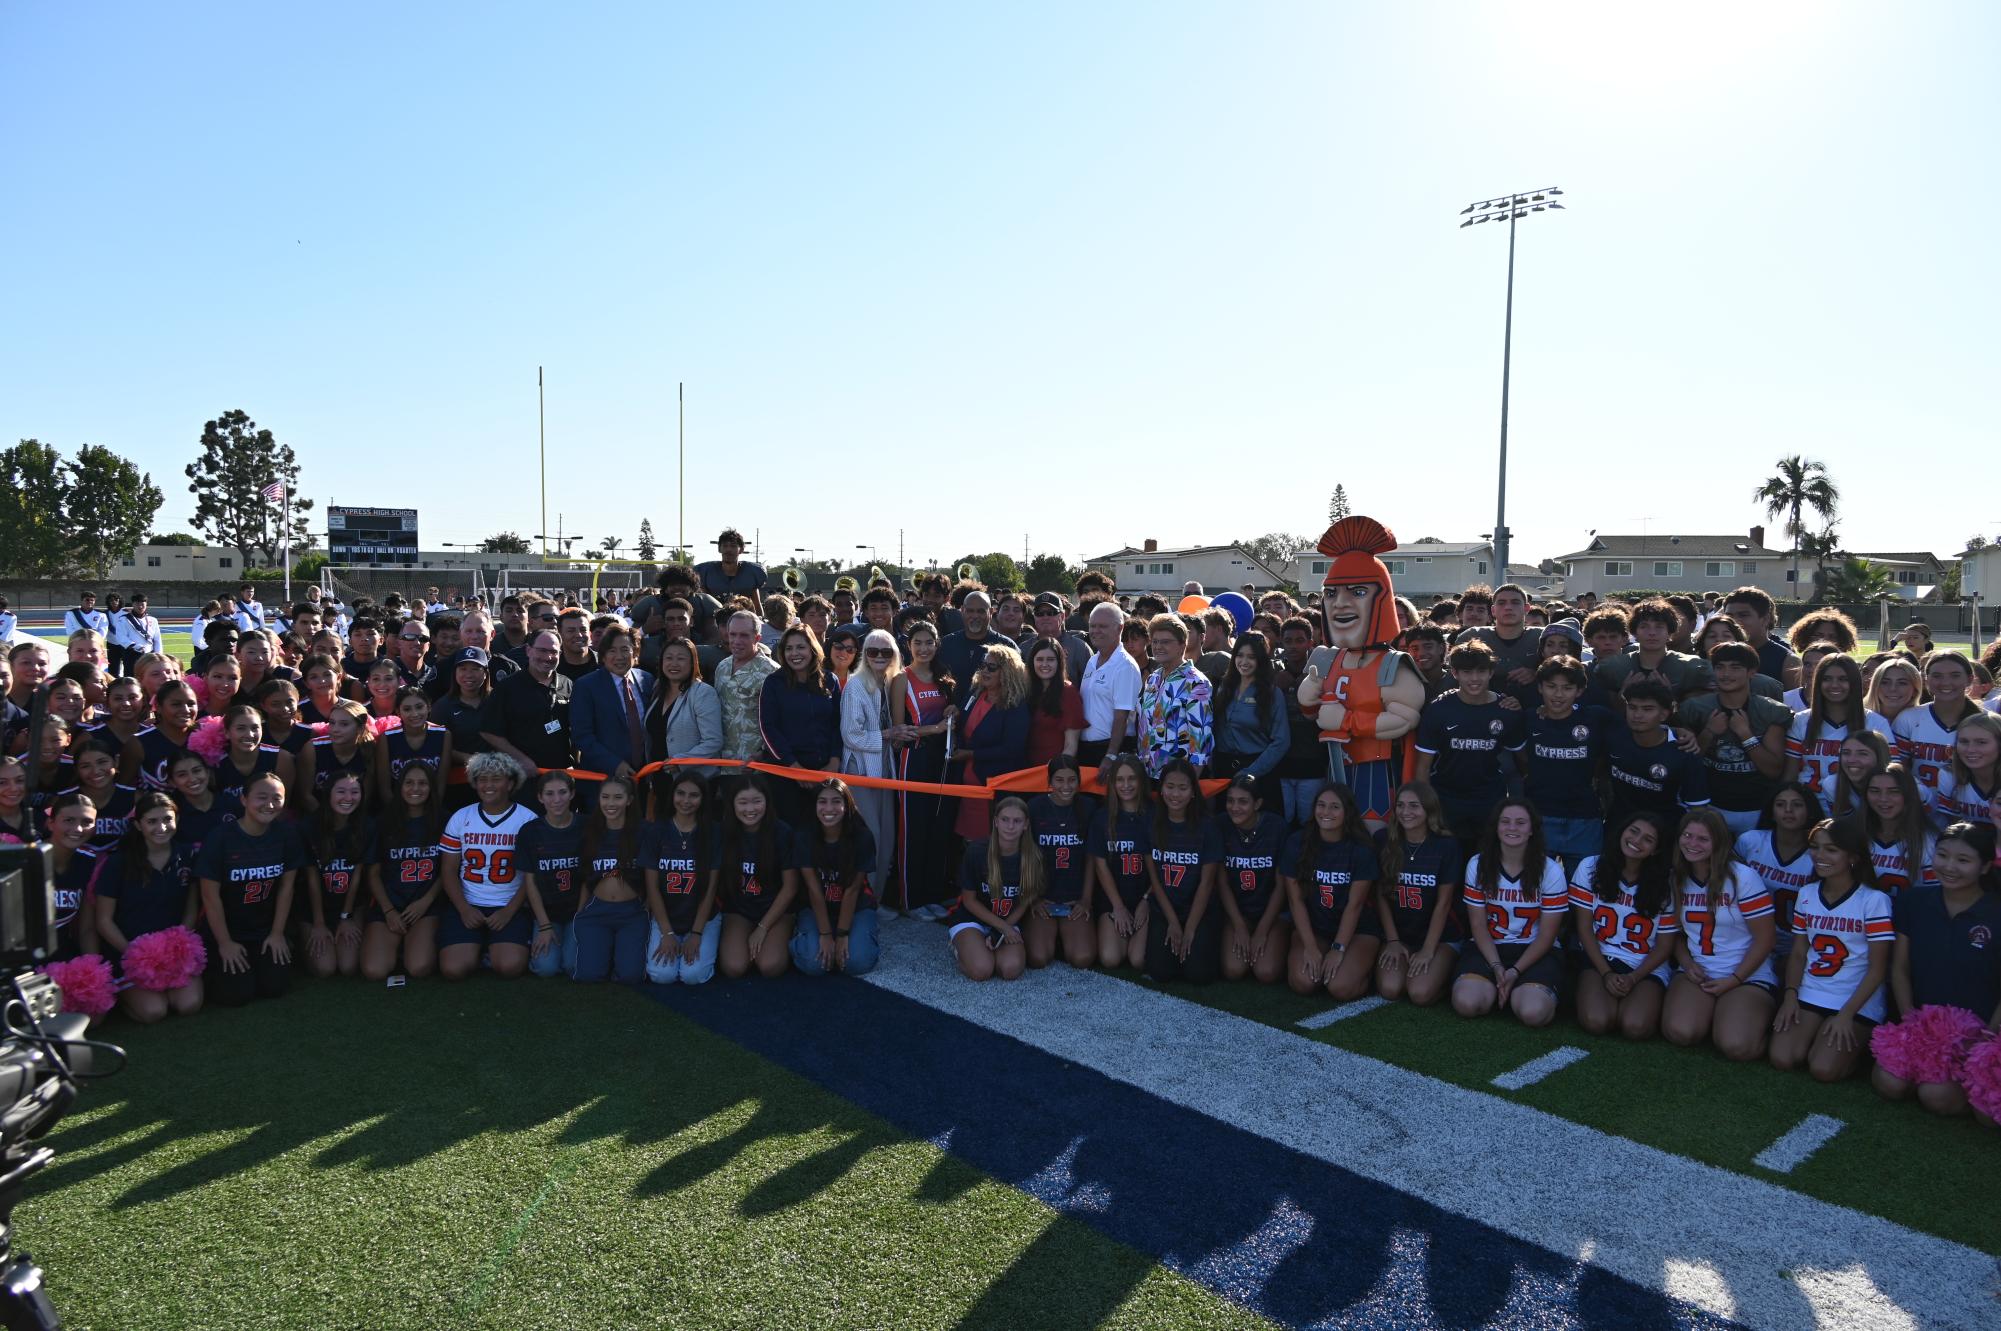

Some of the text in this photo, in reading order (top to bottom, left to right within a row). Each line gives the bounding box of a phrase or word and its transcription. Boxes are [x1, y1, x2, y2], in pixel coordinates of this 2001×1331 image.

[1335, 676, 1350, 700] C
[1450, 738, 1497, 751] CYPRESS
[1535, 743, 1588, 760] CYPRESS
[1611, 765, 1663, 792] CYPRESS
[390, 845, 441, 860] CYPRESS
[1056, 848, 1070, 869] 2
[1152, 848, 1199, 864] CYPRESS
[400, 859, 434, 882] 22
[539, 857, 580, 871] CYPRES
[1120, 854, 1143, 876] 16
[323, 872, 349, 894] 13
[556, 870, 570, 892] 3
[666, 872, 697, 894] 27
[1162, 864, 1186, 887] 17
[1240, 870, 1256, 891] 9
[1319, 884, 1334, 909] 5
[1397, 886, 1423, 910] 15
[1487, 903, 1541, 939] 27
[1593, 904, 1654, 954] 23
[1685, 911, 1716, 956] 7
[1808, 933, 1849, 977] 3
